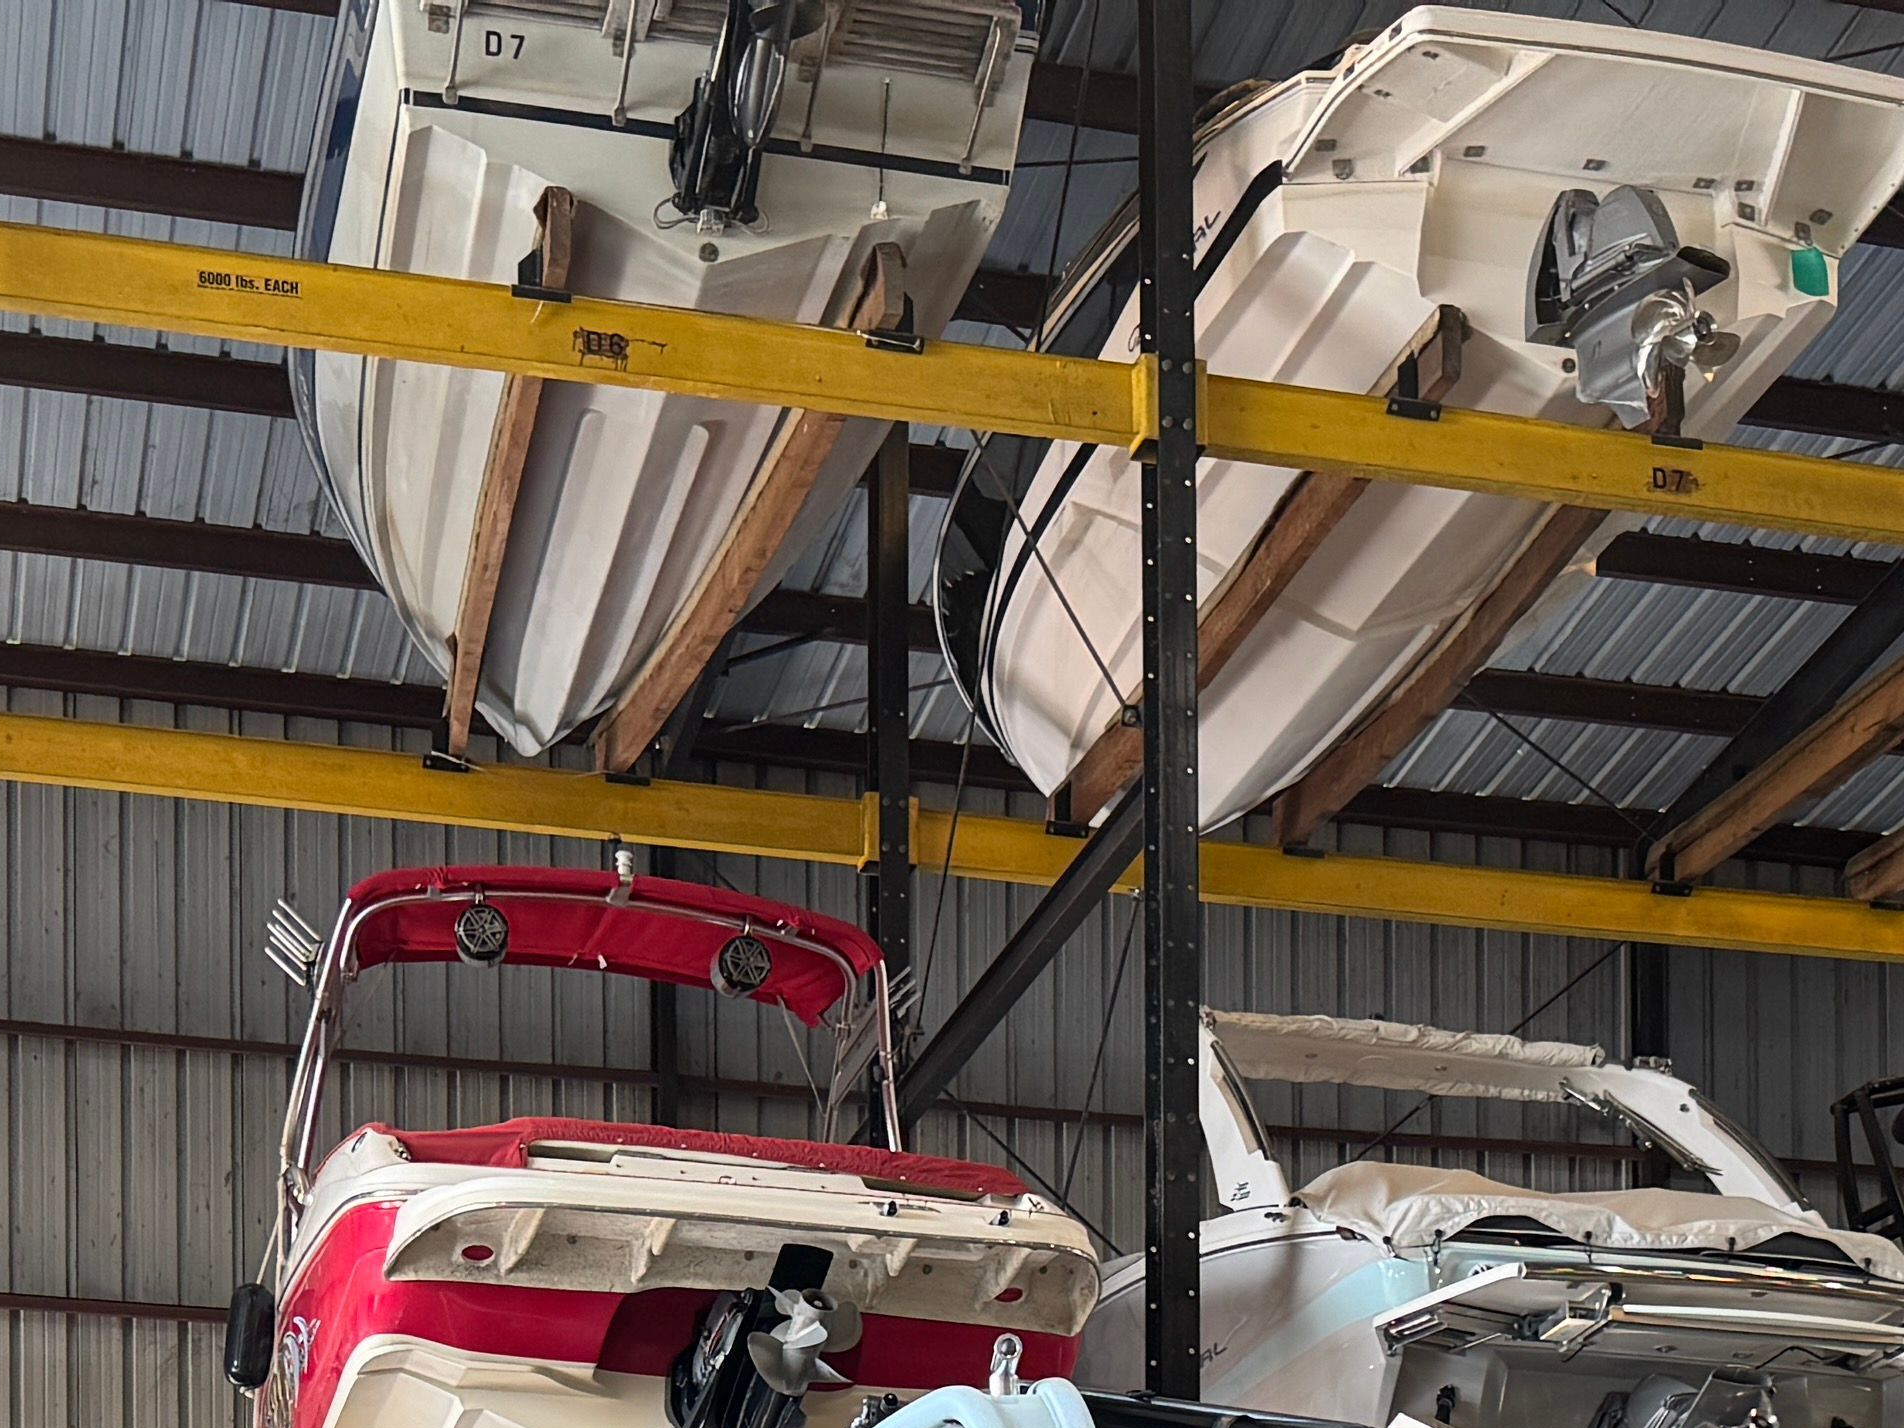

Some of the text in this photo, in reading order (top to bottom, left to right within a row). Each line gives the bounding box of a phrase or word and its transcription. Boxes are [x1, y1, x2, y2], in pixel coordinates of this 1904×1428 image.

[485, 30, 525, 60] D7
[198, 271, 299, 295] 6000 lbs. EACH
[1652, 466, 1684, 491] D7
